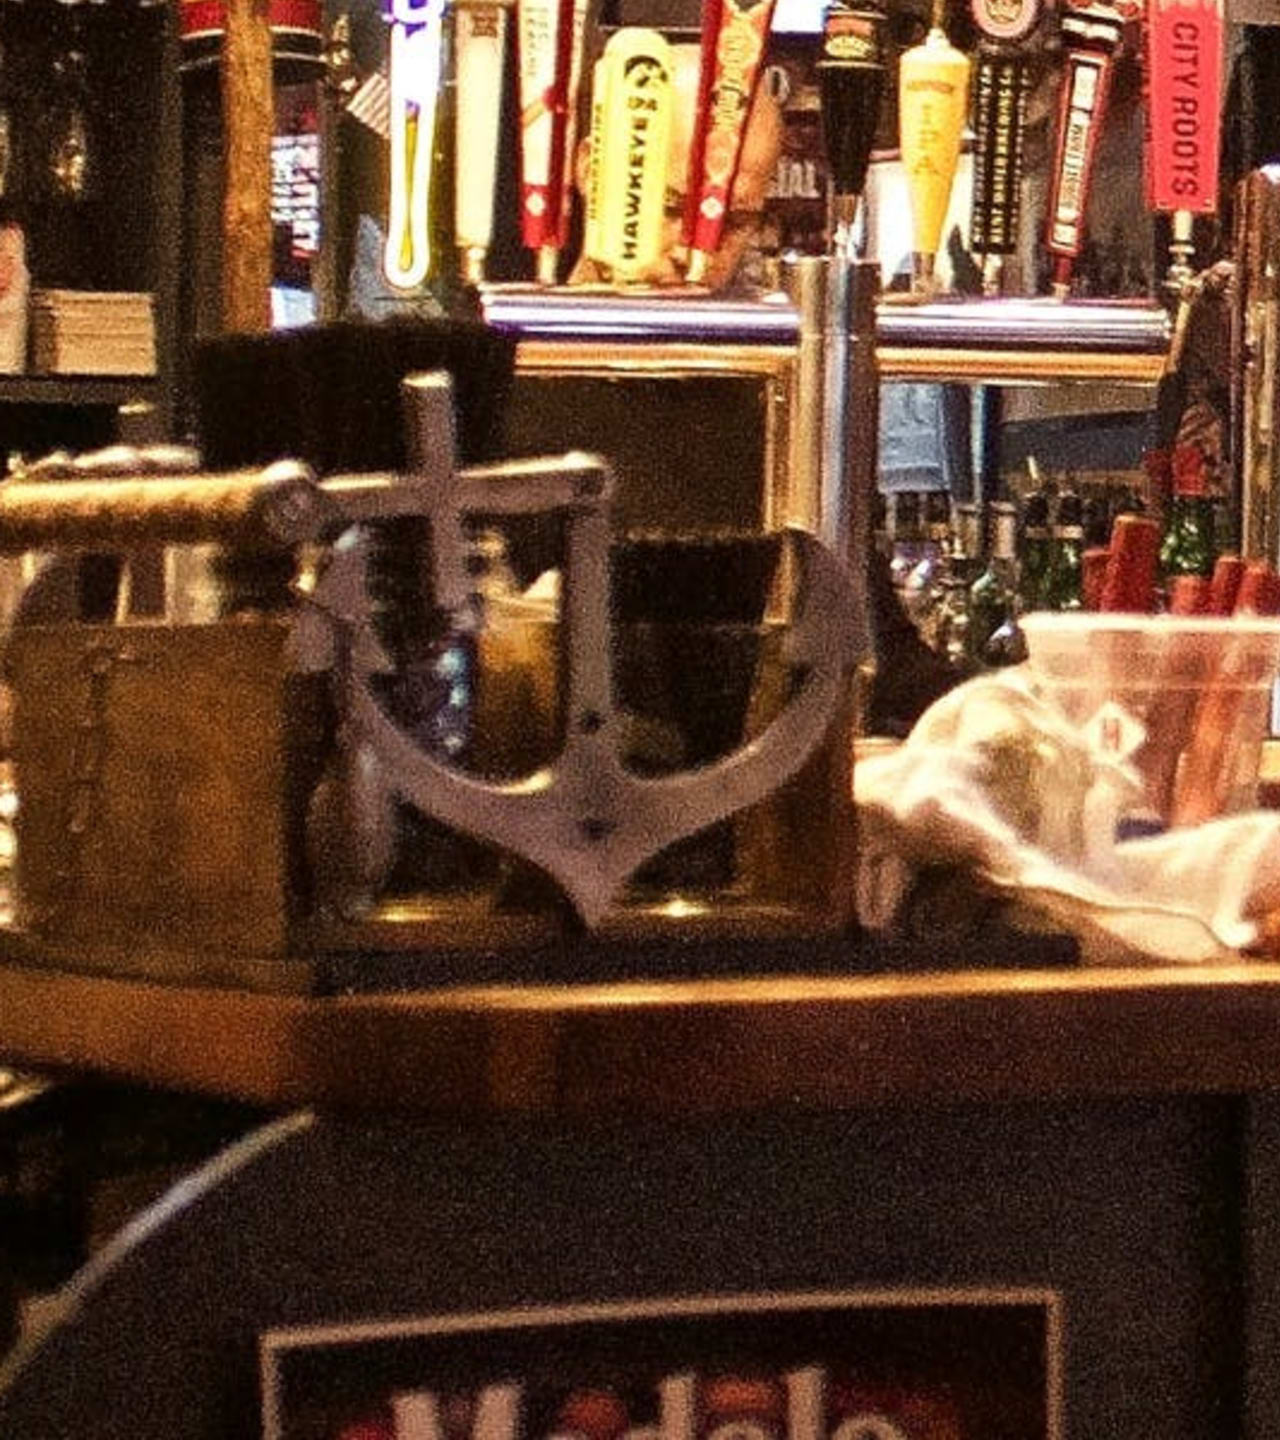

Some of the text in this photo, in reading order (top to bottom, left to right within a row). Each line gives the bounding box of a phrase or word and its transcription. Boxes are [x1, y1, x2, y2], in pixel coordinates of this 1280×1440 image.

[621, 116, 649, 260] HAWKEYE
[1170, 20, 1200, 197] CITY ROOTS
